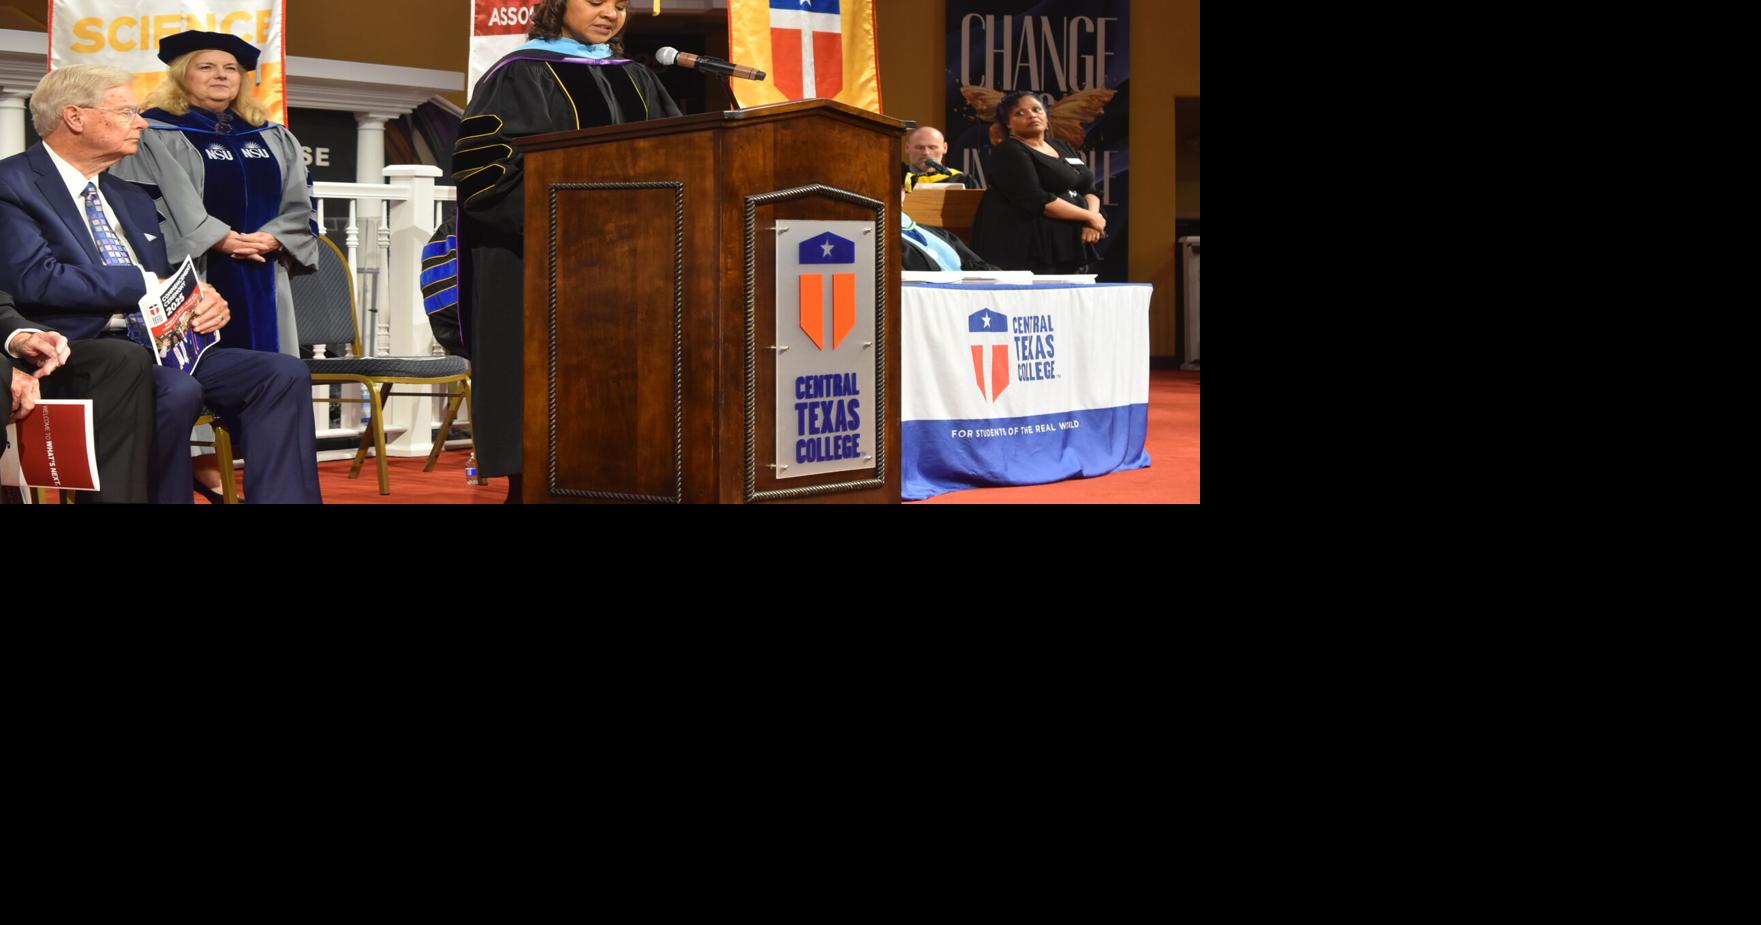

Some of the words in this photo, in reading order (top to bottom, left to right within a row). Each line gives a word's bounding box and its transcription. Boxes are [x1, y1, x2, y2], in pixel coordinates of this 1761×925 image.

[961, 13, 1118, 93] CHANGE
[205, 148, 234, 160] NSU
[241, 147, 270, 159] NSU
[166, 293, 185, 316] 2025
[1012, 314, 1054, 334] CENTRAL
[1014, 334, 1055, 361] TEXAS
[1017, 360, 1056, 382] COLLEGE
[795, 372, 860, 400] CENTRAL
[794, 398, 861, 436] TEXAS
[951, 429, 973, 439] FOR
[975, 427, 1007, 438] STUDENTS
[1008, 426, 1019, 436] OF
[1020, 425, 1033, 435] THE
[1035, 423, 1056, 433] REAL
[45, 440, 56, 468] WHAT'S
[795, 433, 861, 464] COLLEGE
